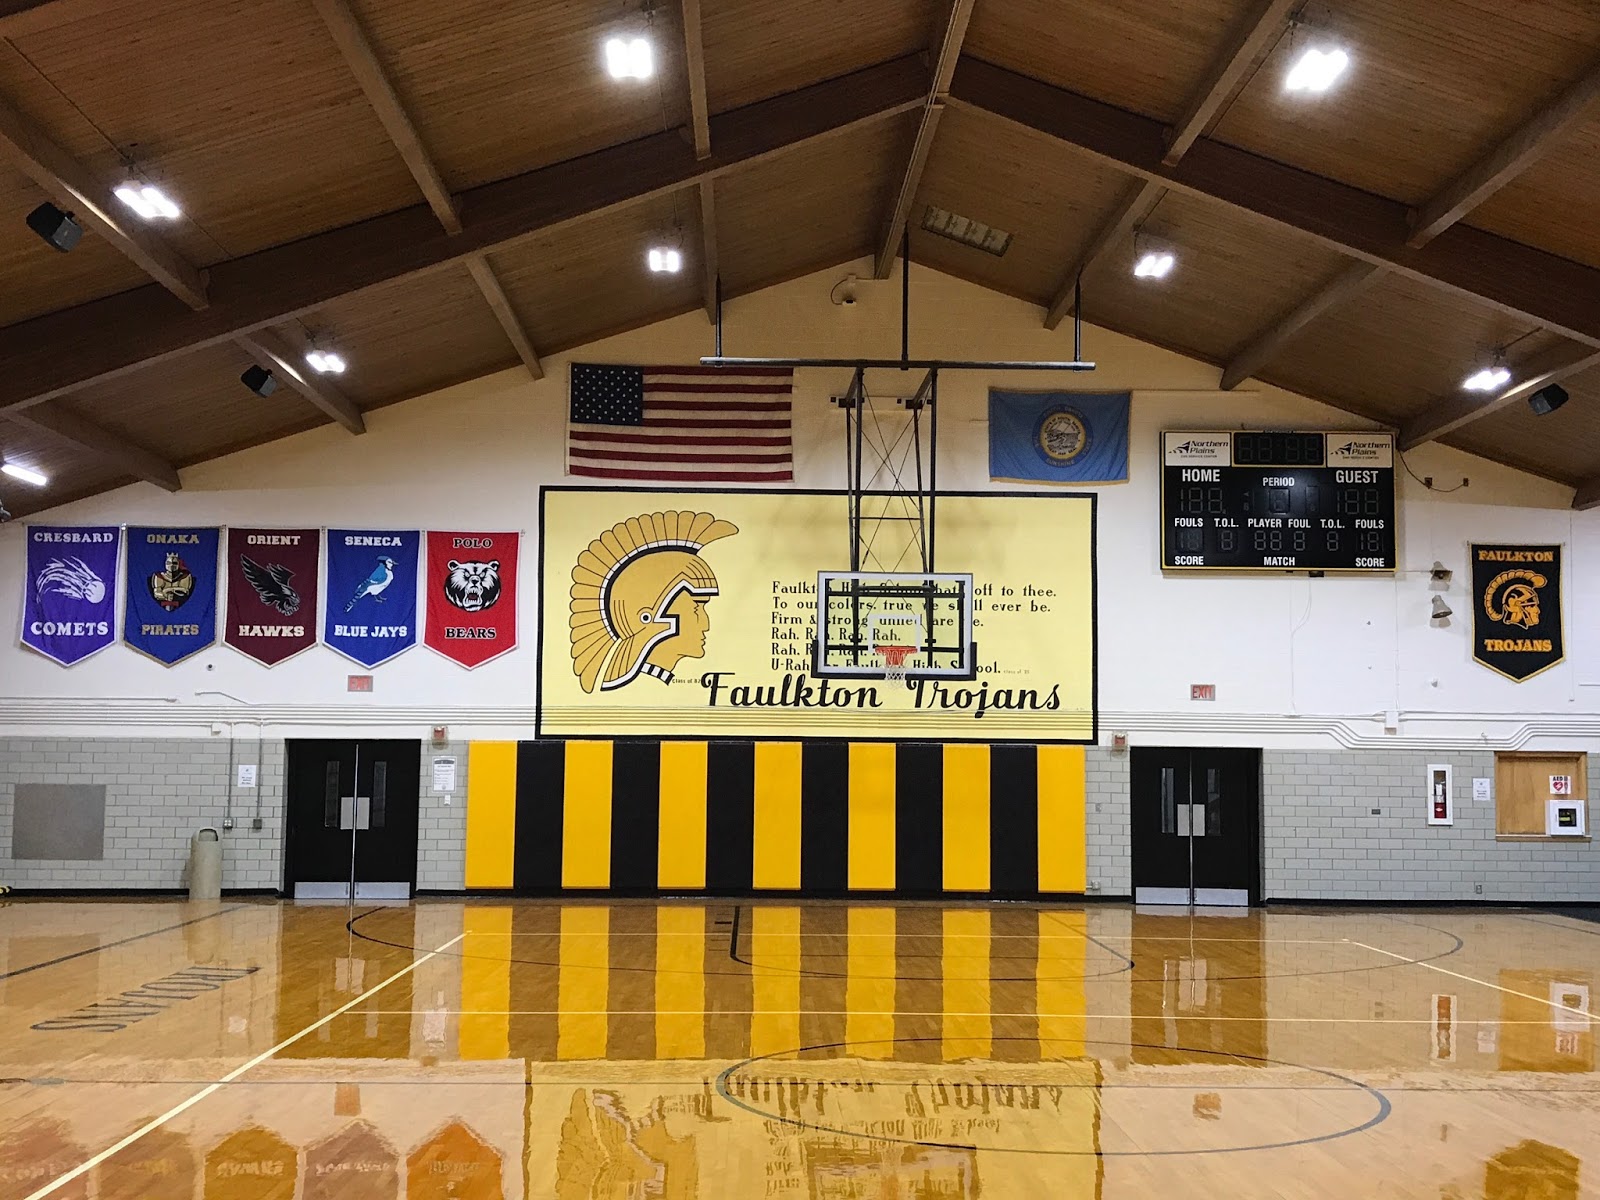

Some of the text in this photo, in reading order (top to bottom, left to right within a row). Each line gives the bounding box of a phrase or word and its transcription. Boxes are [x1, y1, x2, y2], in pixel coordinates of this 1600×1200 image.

[1182, 469, 1220, 482] HOME
[1336, 470, 1378, 484] GUEST
[1262, 477, 1295, 487] PERIOD
[1174, 518, 1203, 528] FOULS
[1214, 518, 1239, 528] T.O.L.
[1248, 518, 1311, 528] PLAYER FOUL
[1320, 519, 1345, 529] T.O.L.
[1356, 520, 1384, 529] FOULS
[34, 532, 114, 544] CRESBARD
[146, 533, 200, 545] ONAKA
[247, 534, 300, 546] ORIENT
[344, 535, 402, 547] SENECA
[452, 537, 493, 550] POLO
[1175, 556, 1204, 566] SCORE
[1264, 557, 1295, 566] MATCH
[1478, 550, 1554, 562] FAULKTON
[1356, 558, 1384, 567] SCORE
[974, 584, 992, 596] off
[1001, 586, 1014, 596] to
[773, 596, 788, 609] To
[883, 600, 912, 610] true
[948, 599, 982, 611] sll
[992, 603, 1021, 612] ever
[1030, 600, 1050, 612] be.
[772, 612, 802, 624] Firm
[810, 614, 817, 624] &
[30, 620, 109, 637] COMETS
[141, 623, 200, 636] PIRATES
[238, 624, 305, 638] HAWKS
[334, 624, 408, 638] BLUE JAYS
[445, 626, 496, 640] BEARS
[1484, 639, 1552, 652] TROJANS
[701, 672, 1060, 718] Faulkton Trojans
[1192, 686, 1213, 698] EXIT
